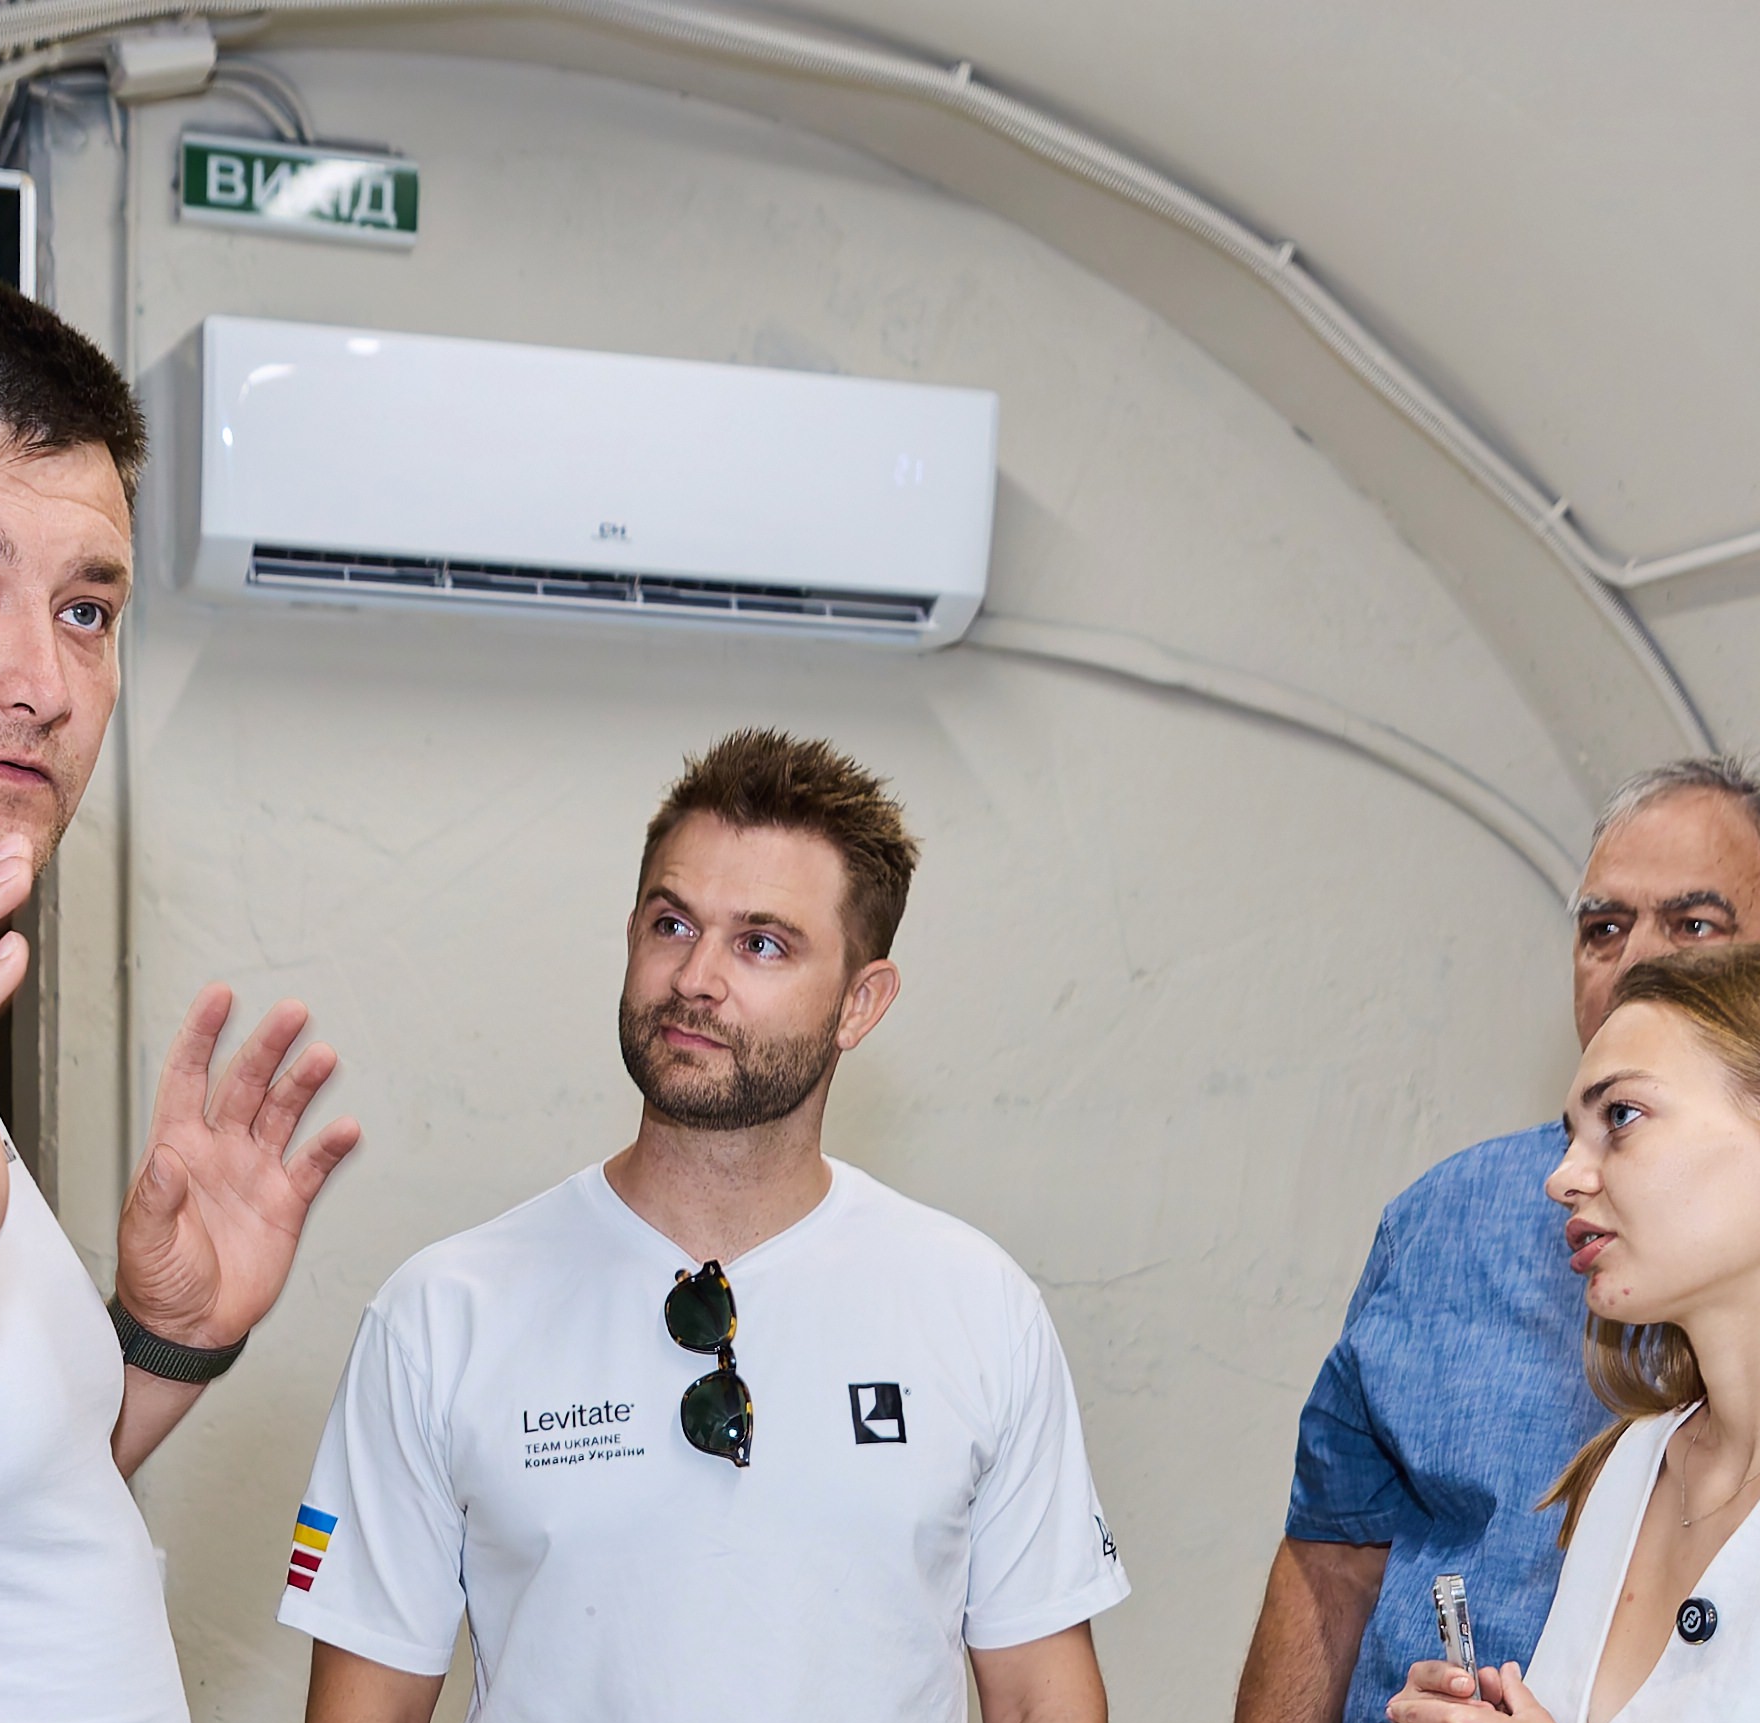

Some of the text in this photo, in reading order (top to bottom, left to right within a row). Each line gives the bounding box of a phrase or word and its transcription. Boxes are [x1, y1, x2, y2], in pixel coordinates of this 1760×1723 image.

[523, 1400, 631, 1433] Levitate
[525, 1433, 622, 1455] TEAM UKRAINE
[525, 1447, 645, 1469] Команда України
